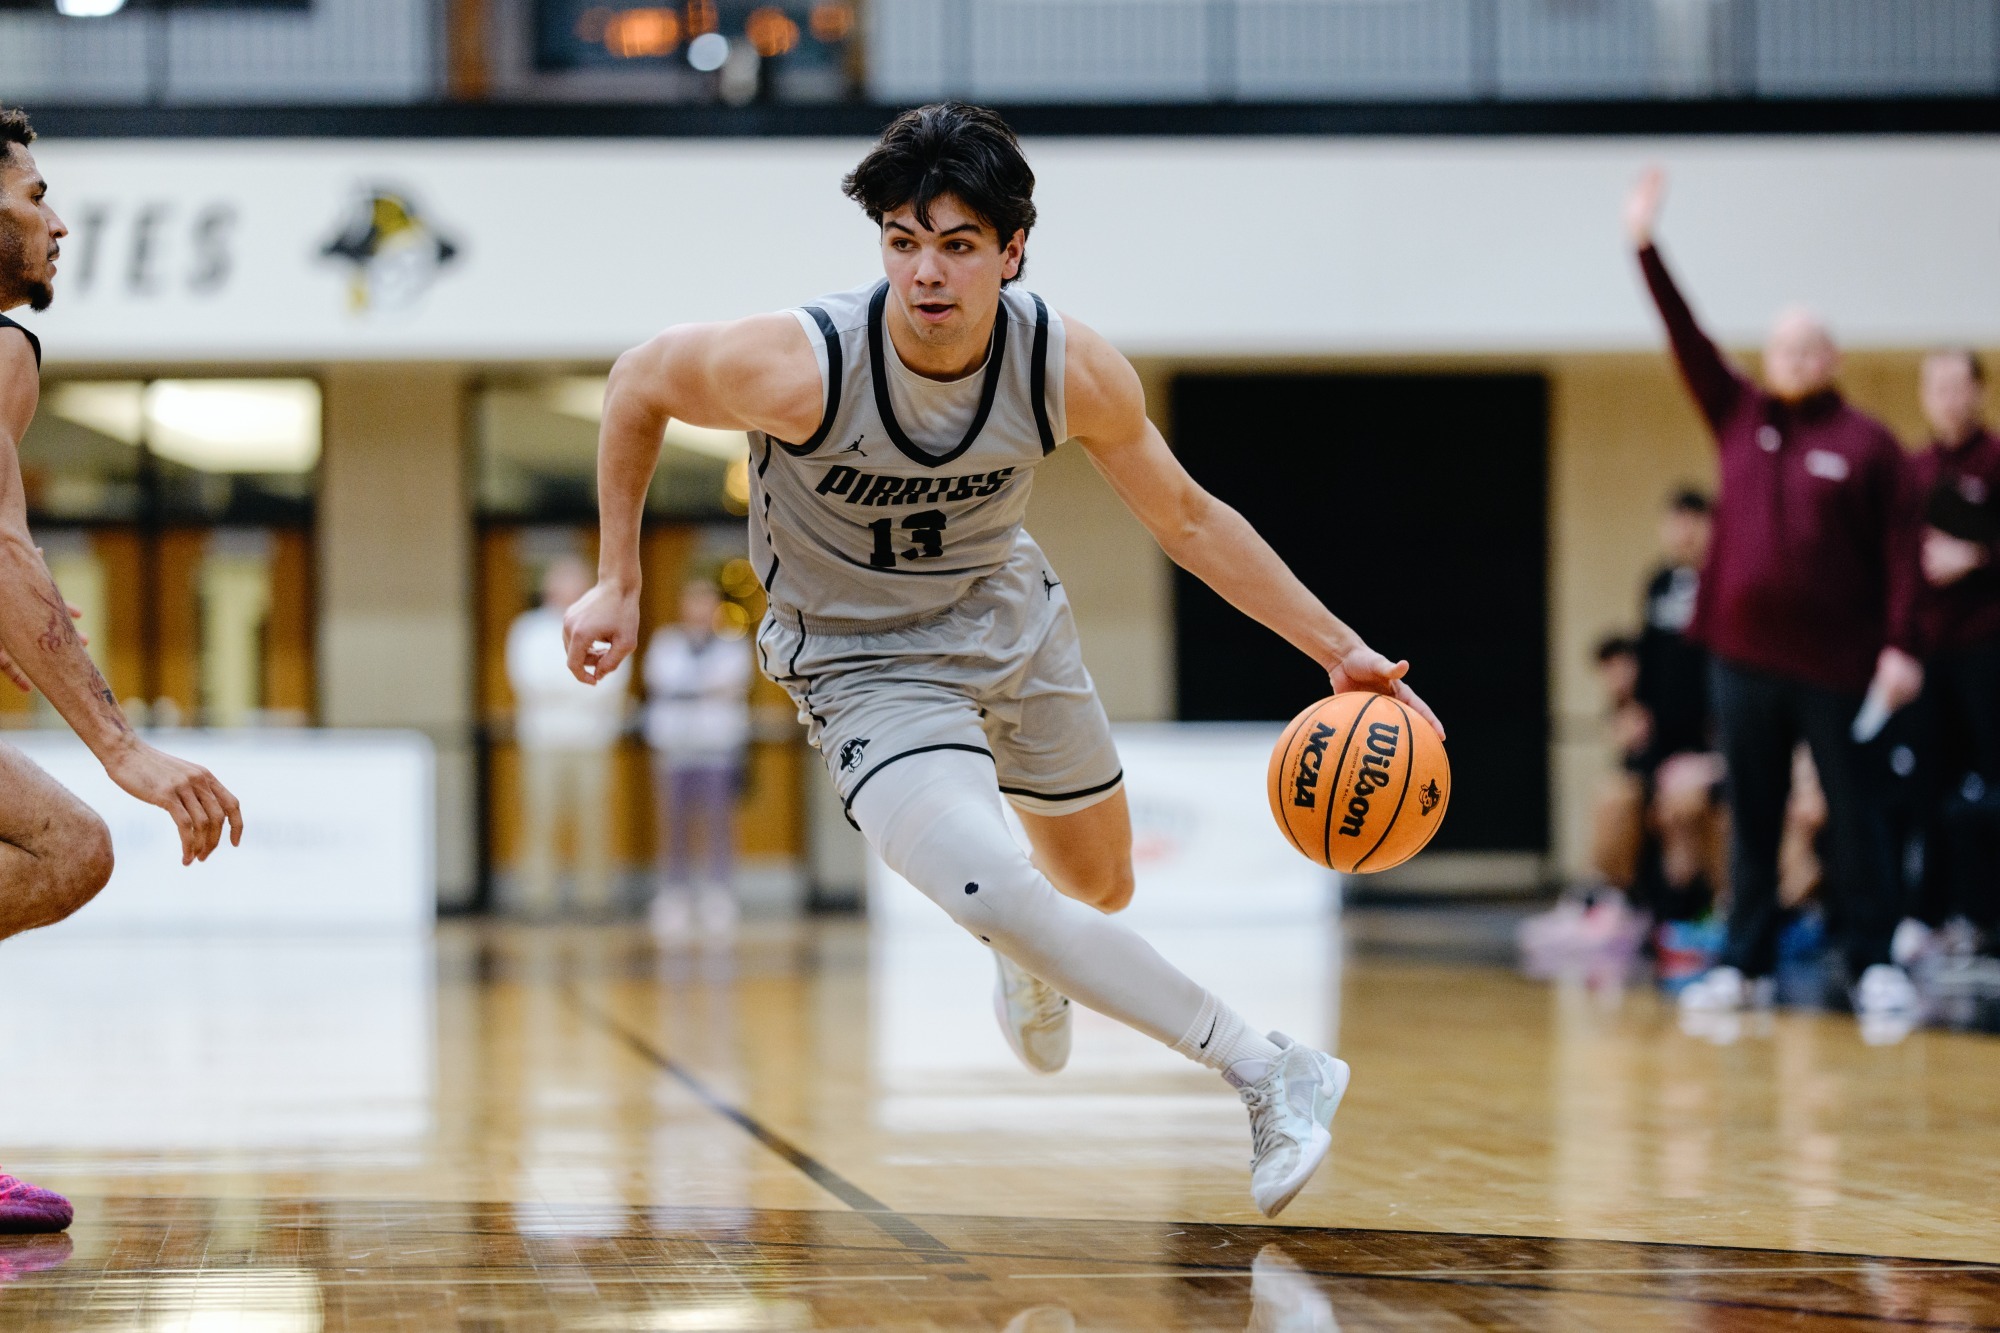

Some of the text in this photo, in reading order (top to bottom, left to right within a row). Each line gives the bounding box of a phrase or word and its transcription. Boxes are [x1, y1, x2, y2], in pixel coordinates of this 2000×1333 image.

[815, 464, 1016, 506] PIRATES
[868, 509, 947, 567] 13
[1294, 721, 1337, 808] NCAA
[1338, 721, 1399, 837] Wilson
